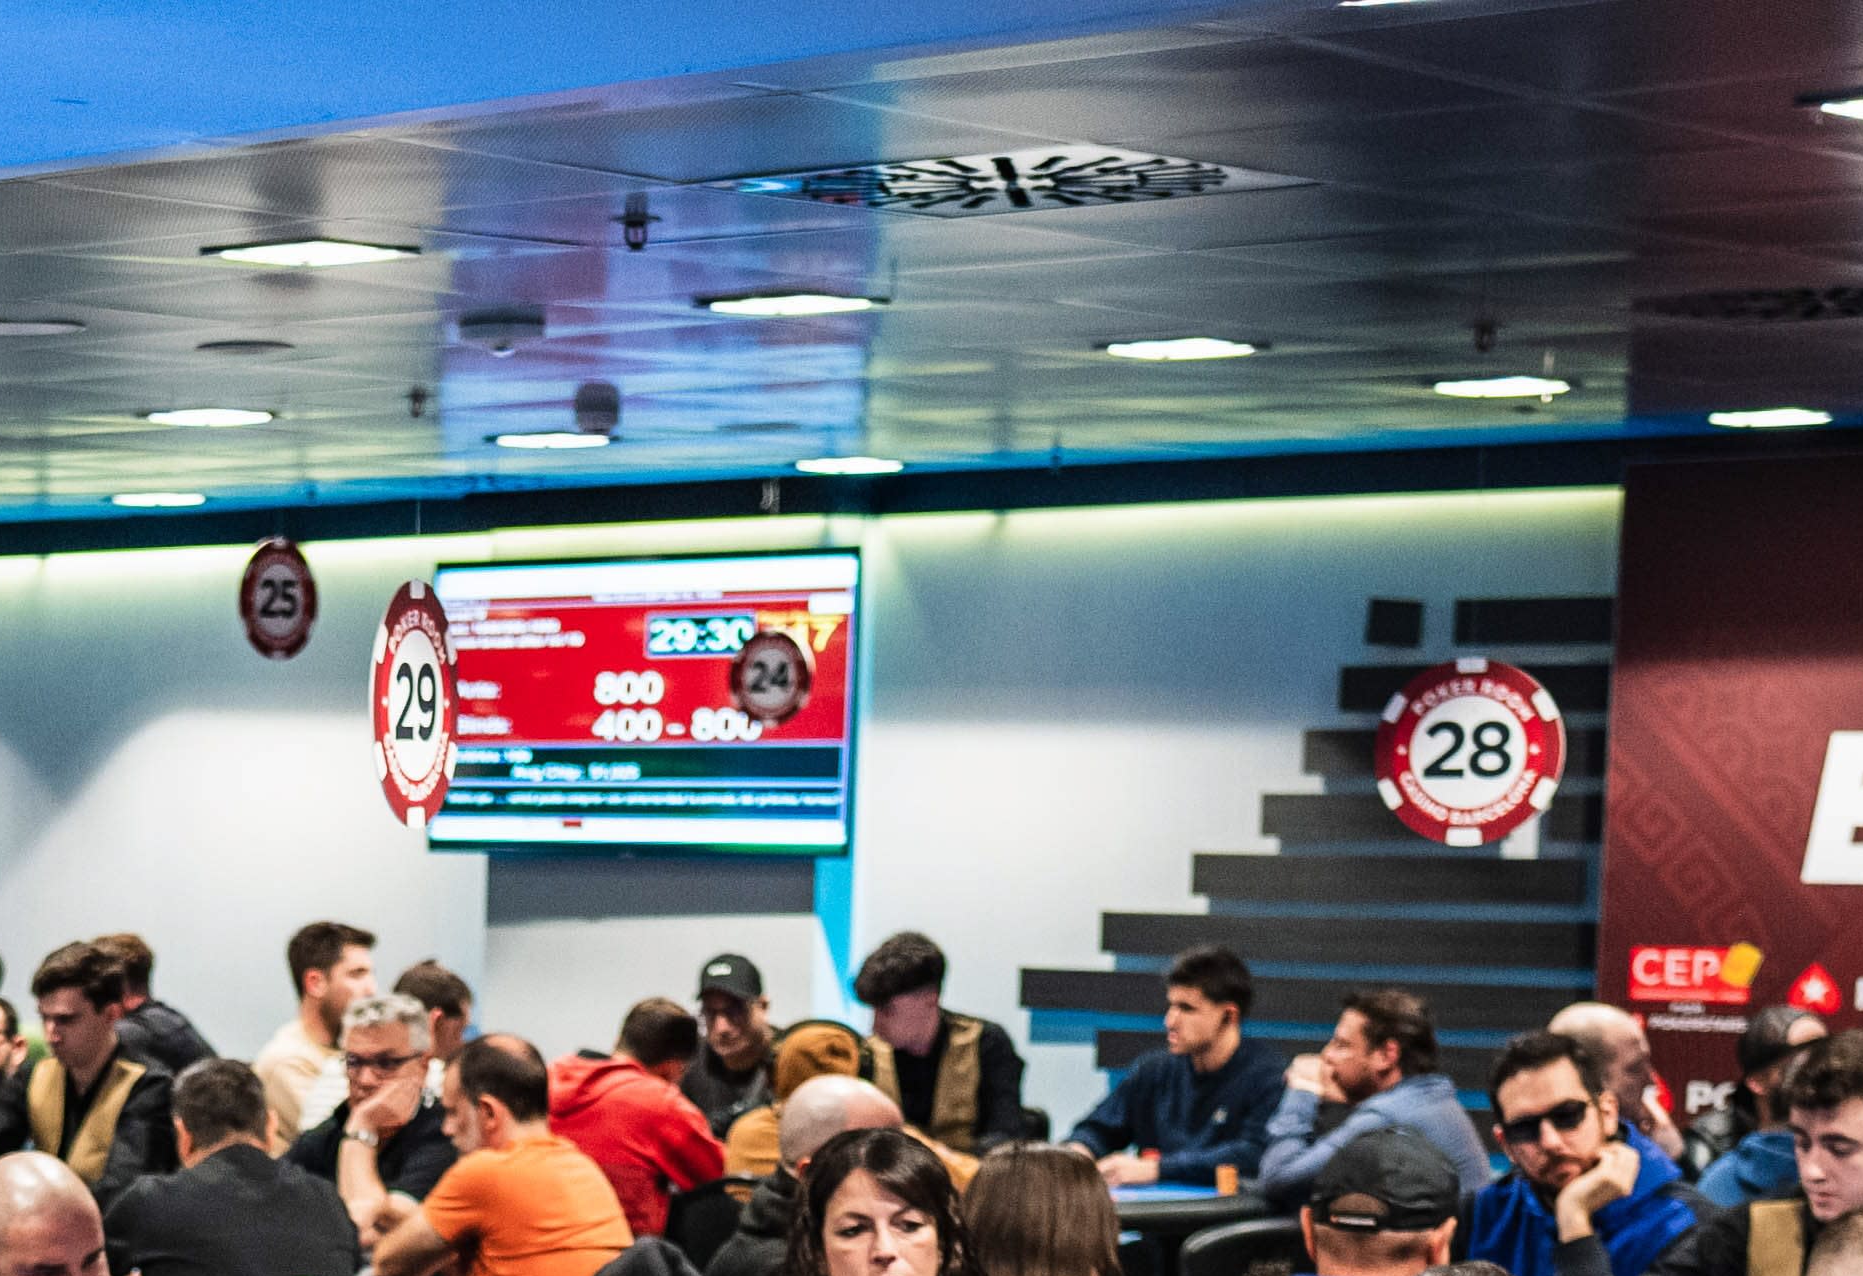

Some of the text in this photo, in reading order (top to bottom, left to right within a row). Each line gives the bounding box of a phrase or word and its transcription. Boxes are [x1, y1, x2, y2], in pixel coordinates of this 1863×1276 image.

[593, 670, 665, 706] 800
[749, 660, 789, 694] 24
[395, 662, 437, 741] 29
[1423, 720, 1511, 779] 28
[1630, 948, 1721, 987] CEP
